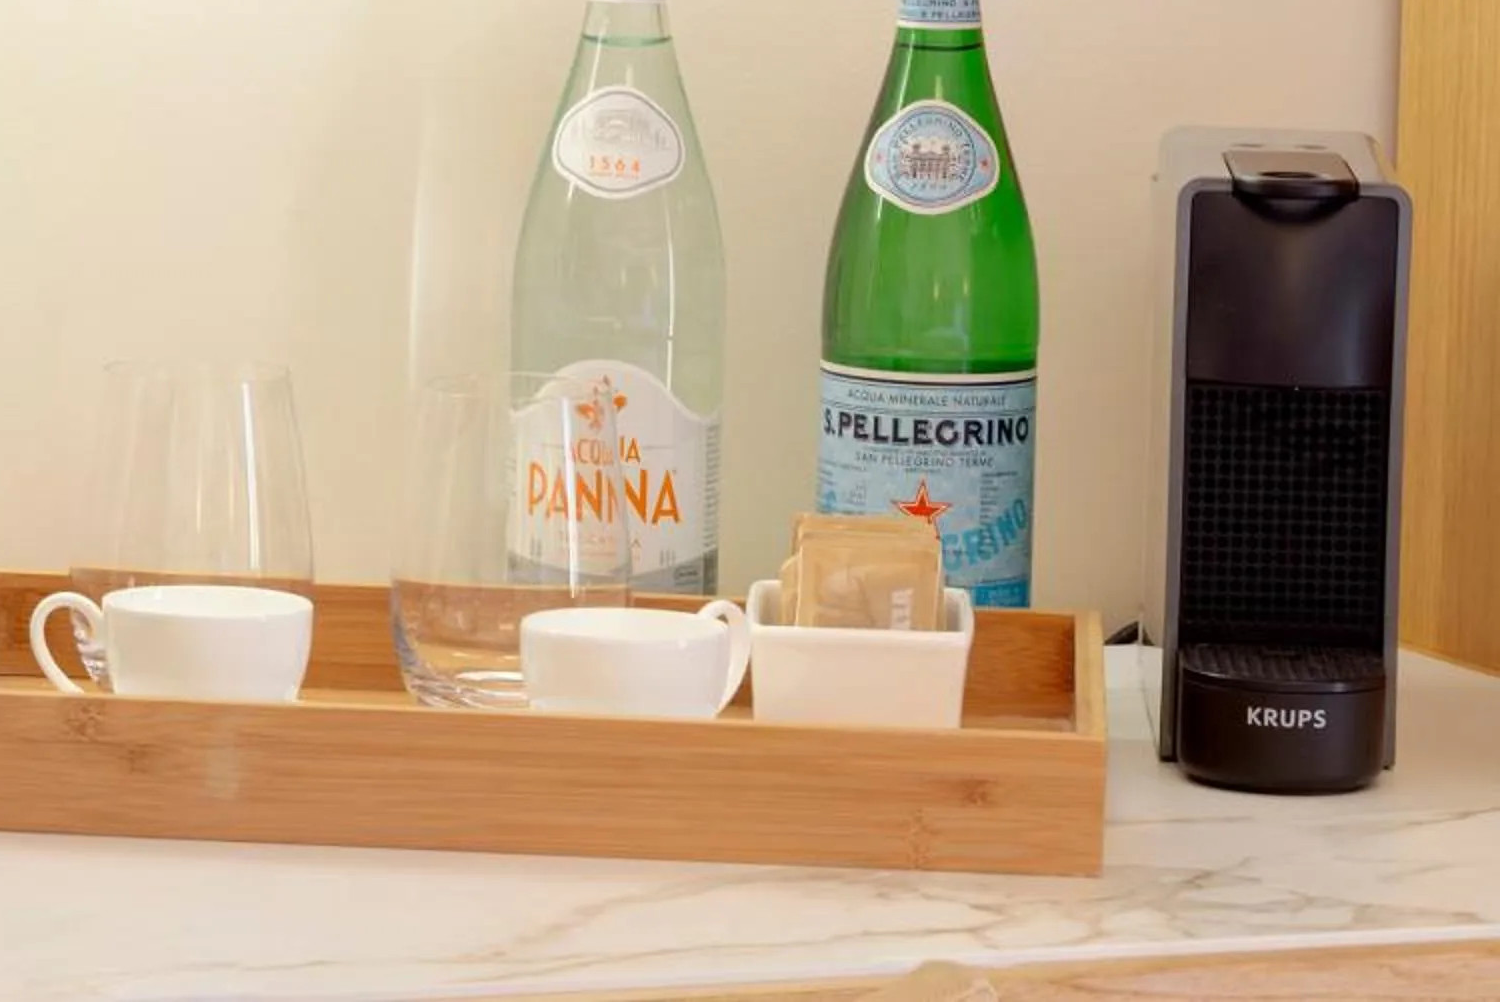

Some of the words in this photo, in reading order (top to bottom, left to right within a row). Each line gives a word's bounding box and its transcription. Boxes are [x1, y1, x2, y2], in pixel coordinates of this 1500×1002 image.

[848, 388, 886, 403] ACQUA
[887, 393, 948, 407] MINERALE
[823, 407, 1030, 447] S.PELLEGRINO
[881, 453, 956, 468] PELLEGRINO
[526, 461, 681, 526] PANNA
[1246, 706, 1328, 729] KRUPS
